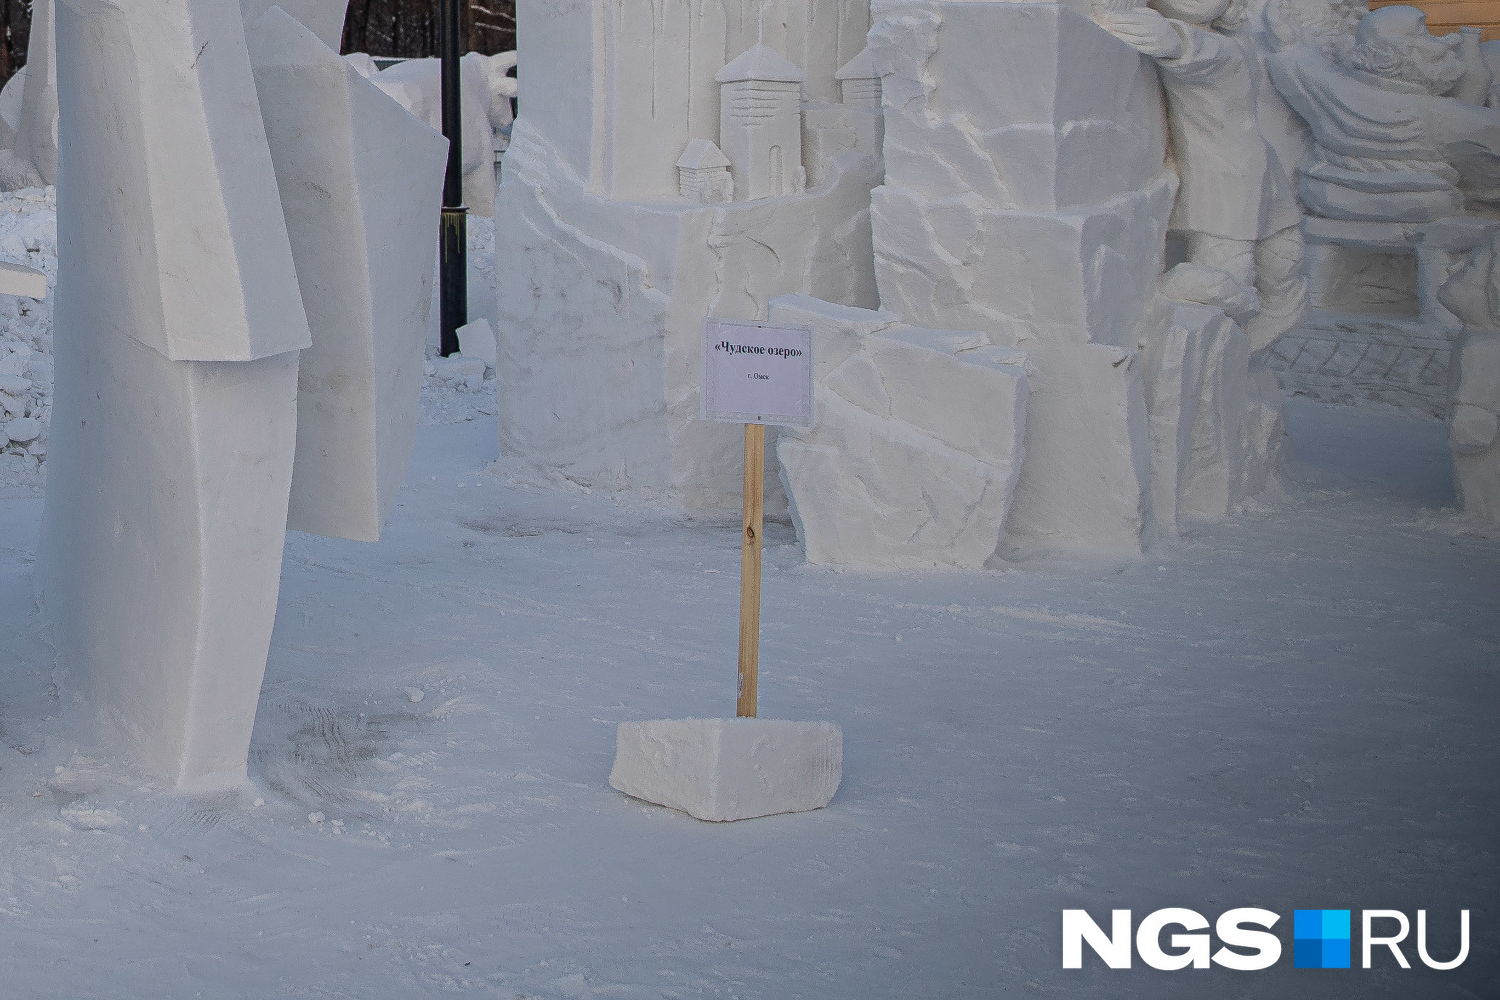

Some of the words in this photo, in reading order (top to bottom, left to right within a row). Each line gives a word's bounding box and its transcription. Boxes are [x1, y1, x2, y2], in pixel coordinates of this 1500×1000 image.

[715, 341, 766, 356] «Чудское
[767, 346, 803, 359] озеро»
[753, 372, 770, 381] Омск
